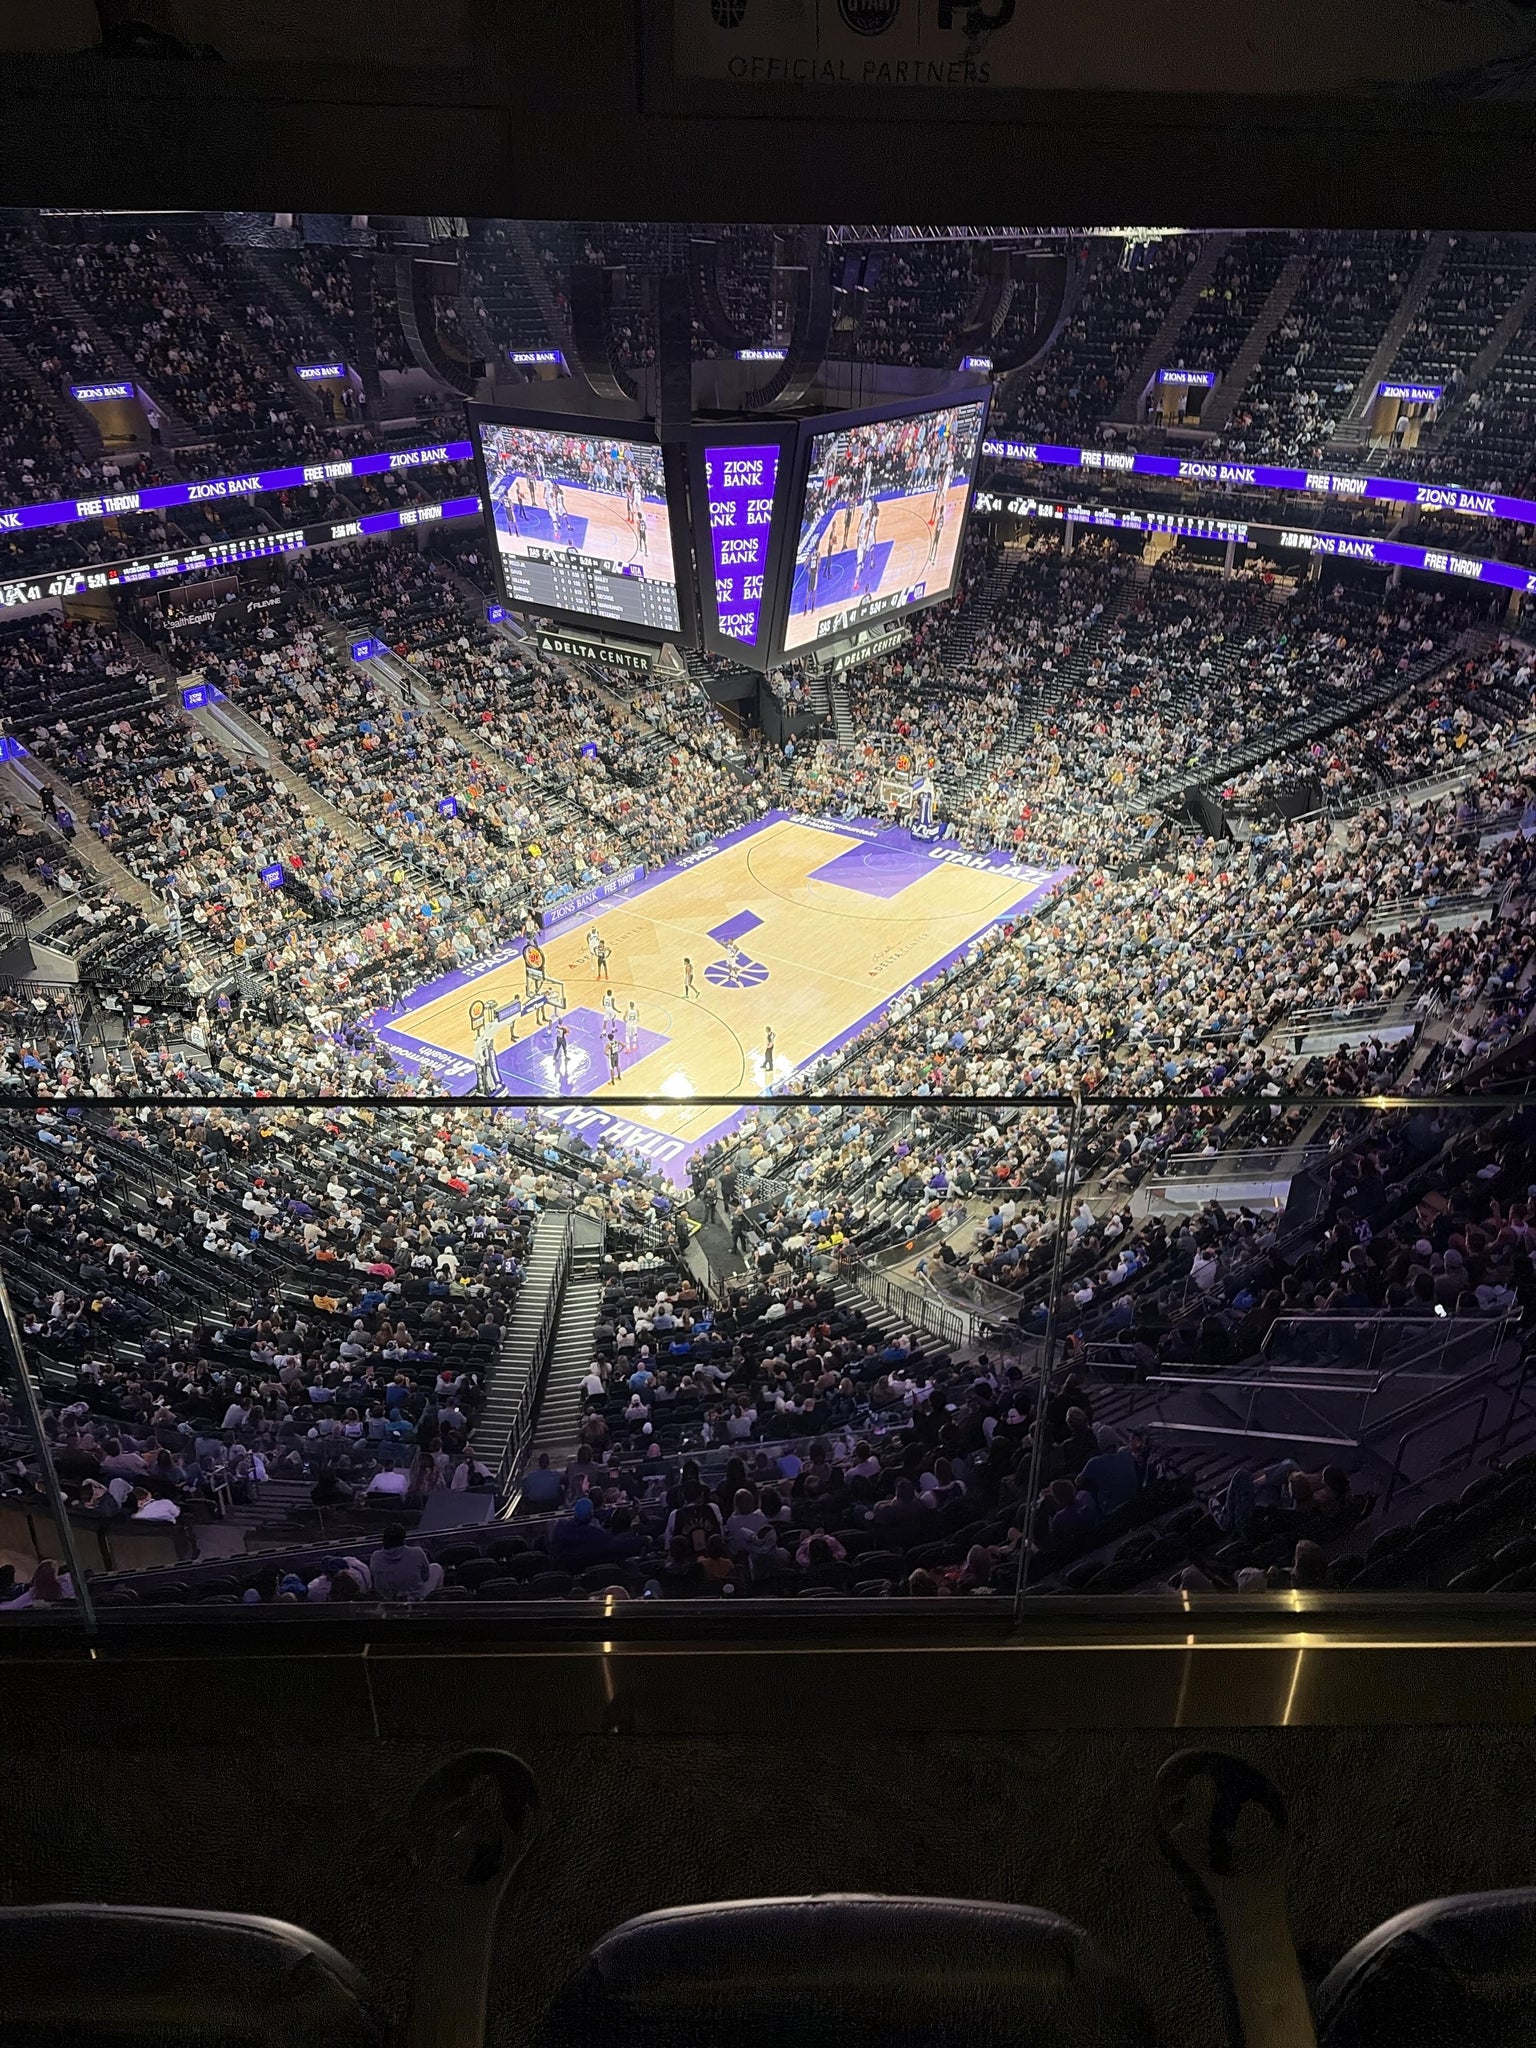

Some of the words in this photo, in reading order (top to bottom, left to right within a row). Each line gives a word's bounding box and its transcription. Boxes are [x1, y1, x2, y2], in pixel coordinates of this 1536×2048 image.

[728, 57, 847, 81] OFFICIAL
[862, 61, 991, 83] PARTNERS
[513, 353, 535, 362] ZIONS
[536, 353, 556, 361] BANK
[740, 350, 762, 360] ZIONS
[763, 351, 784, 360] BANK
[969, 358, 990, 368] ZIONS
[300, 369, 321, 378] ZIONS
[321, 366, 340, 375] BANK
[1163, 372, 1186, 382] ZIONS
[1187, 374, 1208, 384] BANK
[77, 388, 103, 399] ZIONS
[104, 386, 127, 396] BANK
[1384, 386, 1410, 398] ZIONS
[1411, 388, 1436, 400] BANK
[390, 452, 419, 467] ZIONS
[421, 448, 448, 463] BANK
[1007, 445, 1037, 459] BANK
[1081, 450, 1102, 465] FREE
[1103, 453, 1135, 469] THROW
[304, 467, 324, 481] FREE
[324, 462, 352, 477] THROW
[724, 460, 763, 473] ZIONS
[1179, 462, 1217, 478] ZIONS
[1219, 466, 1255, 482] BANK
[724, 473, 763, 487] BANK
[1306, 474, 1330, 490] FREE
[1332, 477, 1367, 494] THROW
[188, 483, 227, 499] ZIONS
[229, 477, 263, 493] BANK
[77, 501, 103, 517] FREE
[103, 495, 140, 511] THROW
[992, 499, 1002, 511] 41
[1008, 501, 1019, 513] 47
[1417, 488, 1457, 507] ZIONS
[1459, 495, 1495, 512] BANK
[400, 510, 419, 524] FREE
[419, 506, 442, 520] THROW
[711, 514, 737, 527] NK
[721, 538, 759, 551] ZIONS
[1298, 535, 1312, 550] PM
[1338, 540, 1375, 557] BANK
[721, 551, 759, 565] BANK
[1424, 553, 1447, 569] FREE
[1448, 557, 1482, 577] THROW
[630, 566, 641, 575] UTA
[28, 586, 41, 599] 41
[49, 582, 62, 595] 47
[253, 597, 281, 609] FILEVINE
[163, 611, 217, 629] HealthEquity
[719, 613, 754, 627] ZIONS
[719, 625, 754, 638] BANK
[554, 640, 596, 659] DELTA
[599, 650, 648, 670] CENTER
[844, 646, 871, 667] DELTA
[872, 634, 902, 654] CENTER
[805, 821, 836, 832] Health
[684, 845, 720, 864] PACS
[928, 847, 991, 869] UTAH
[988, 863, 1053, 885] JAZZ
[551, 900, 576, 922] ZIONS
[577, 891, 598, 909] BANK
[604, 881, 618, 895] FREE
[617, 872, 635, 888] THROW
[475, 948, 519, 972] PACS
[875, 951, 903, 972] DELTA
[419, 1046, 457, 1065] Health
[599, 1121, 685, 1162] UTAH
